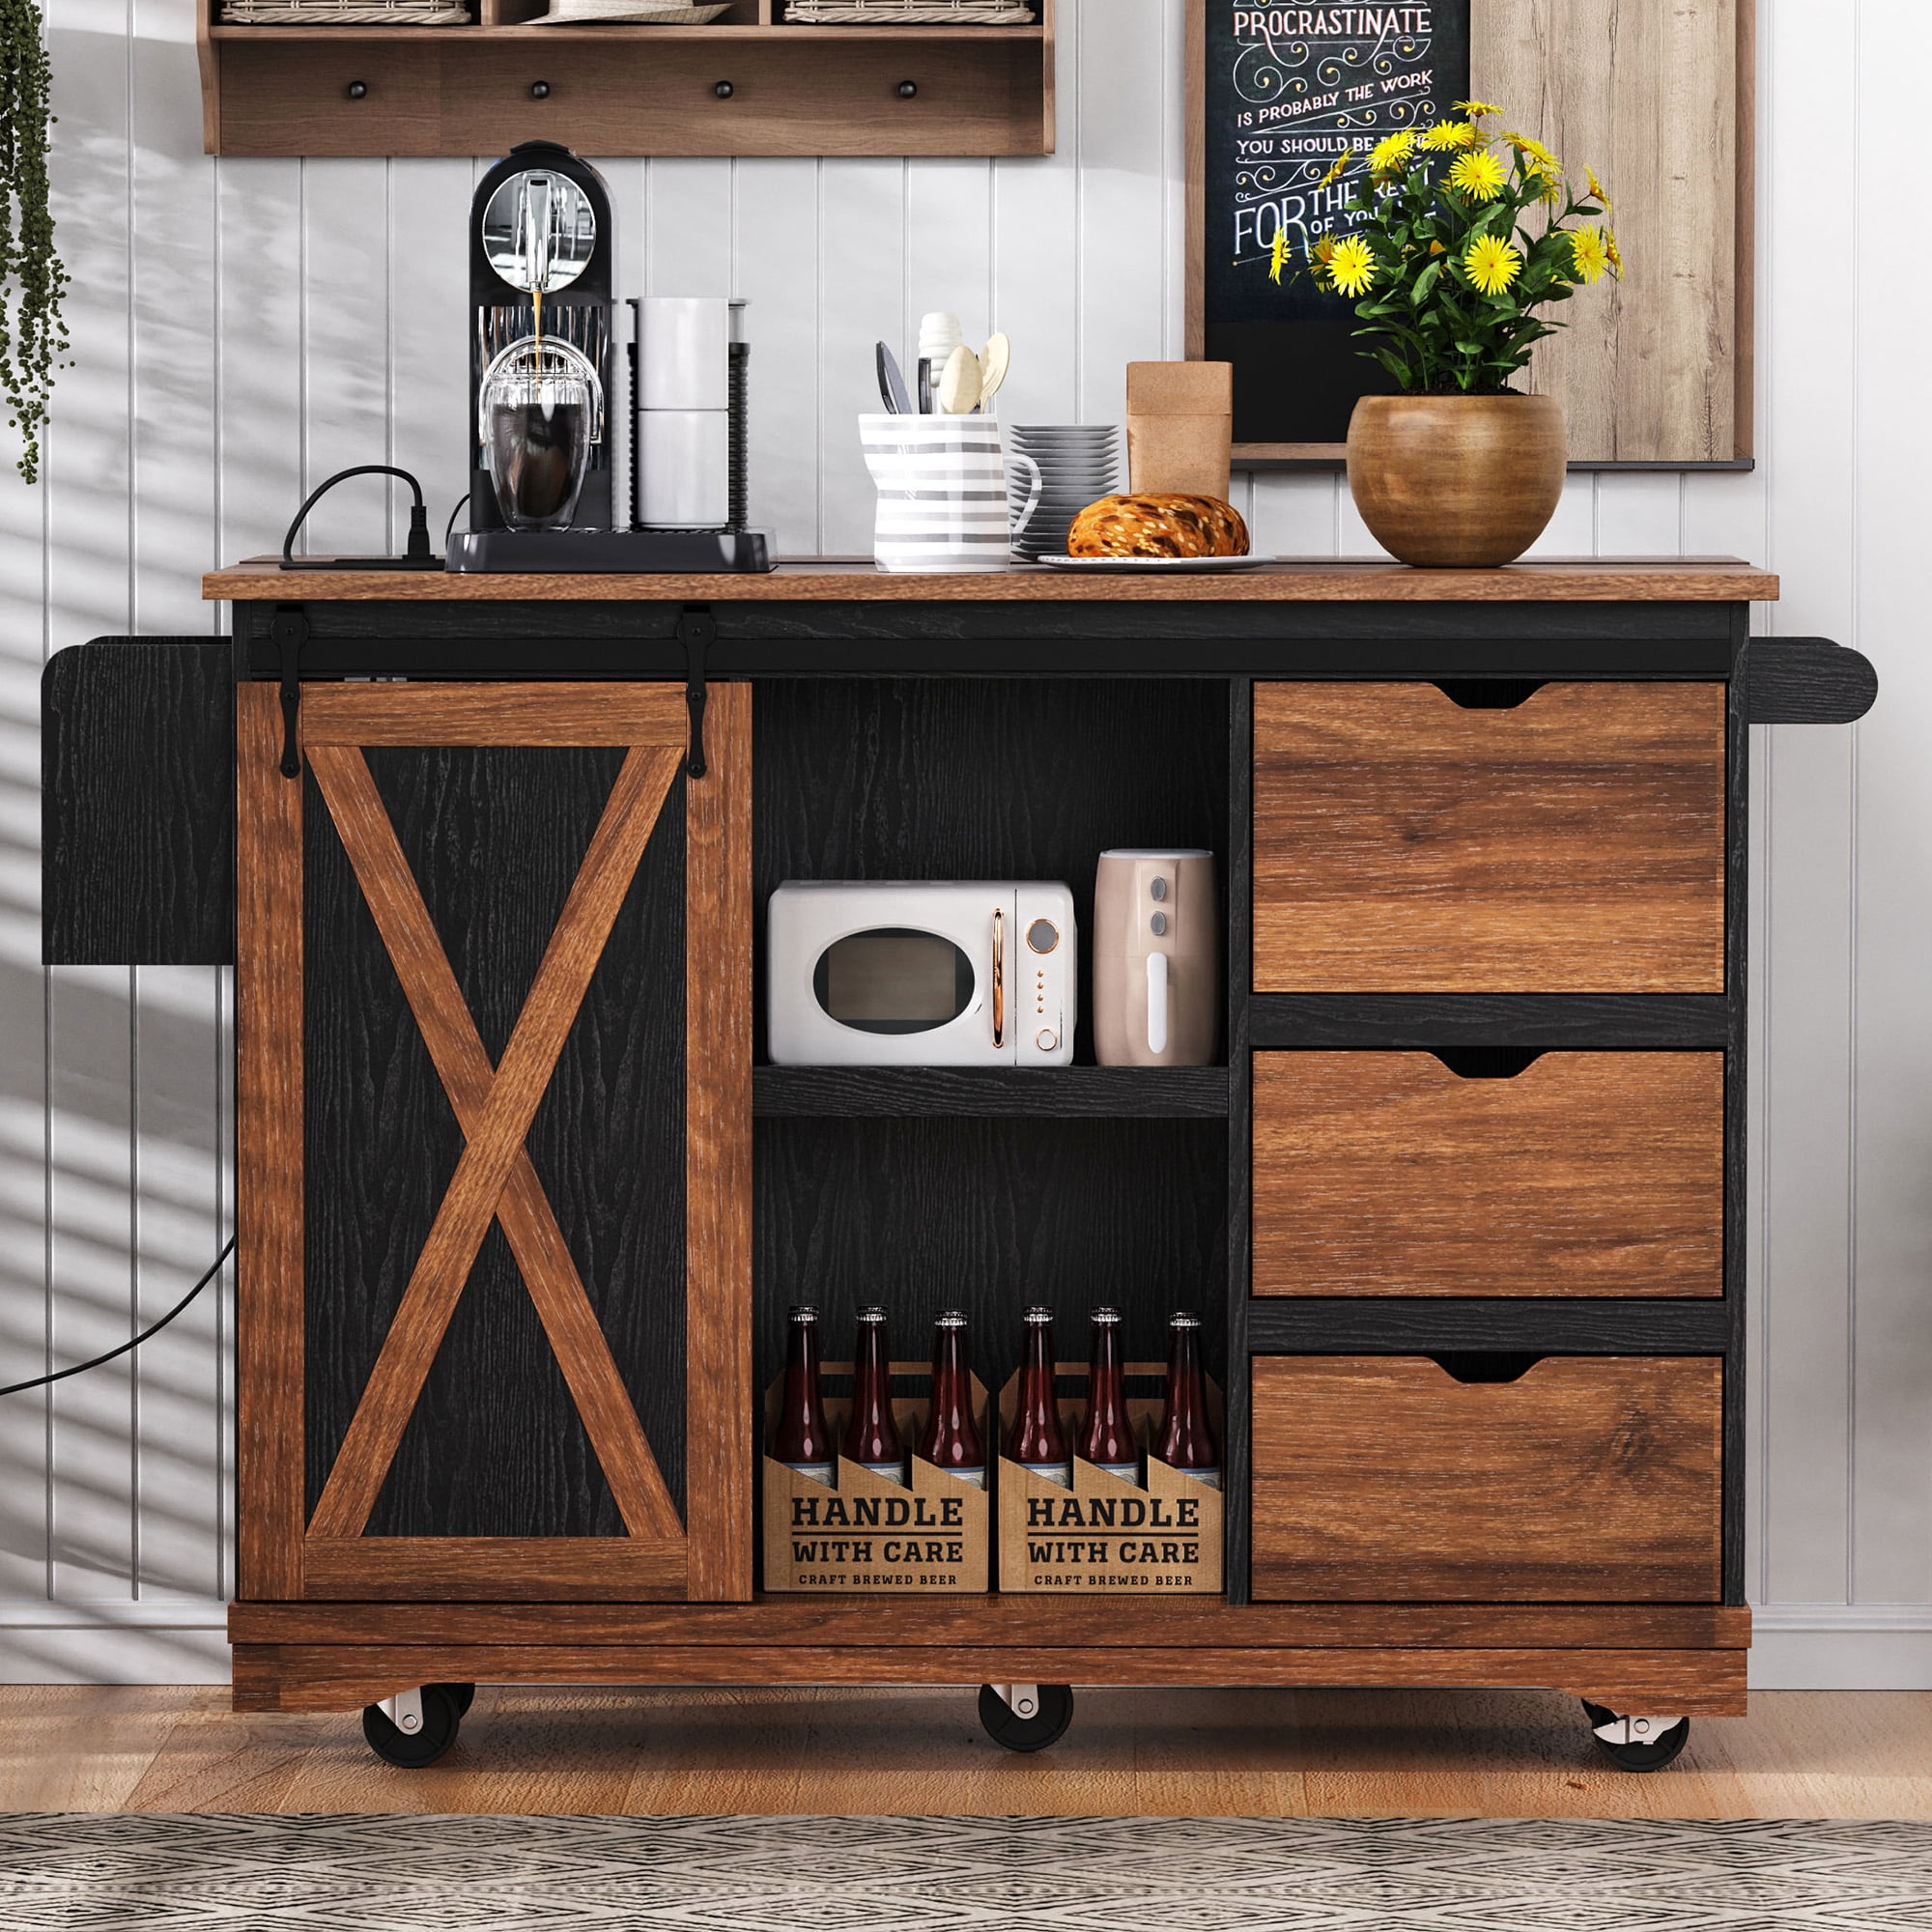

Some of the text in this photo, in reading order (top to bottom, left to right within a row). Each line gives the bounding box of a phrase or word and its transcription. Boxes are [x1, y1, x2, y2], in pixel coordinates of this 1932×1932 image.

[1233, 8, 1433, 39] PROCRASTINATE
[1236, 70, 1434, 128] IS PROBABLY THE WORK
[1236, 139, 1274, 155] YOU
[1280, 136, 1349, 154] SHOULD
[1352, 136, 1375, 152] BE
[1308, 180, 1360, 216] THE
[1235, 195, 1313, 264] FOR
[1310, 216, 1335, 234] OF
[791, 1497, 963, 1526] HANDLE
[1027, 1498, 1199, 1527] HANDLE
[791, 1541, 963, 1563] WITH CARE
[1027, 1542, 1199, 1563] WITH CARE
[799, 1575, 956, 1584] CRAFT BREWED BEER
[1034, 1575, 1193, 1586] CRAFT BREWED BEER
